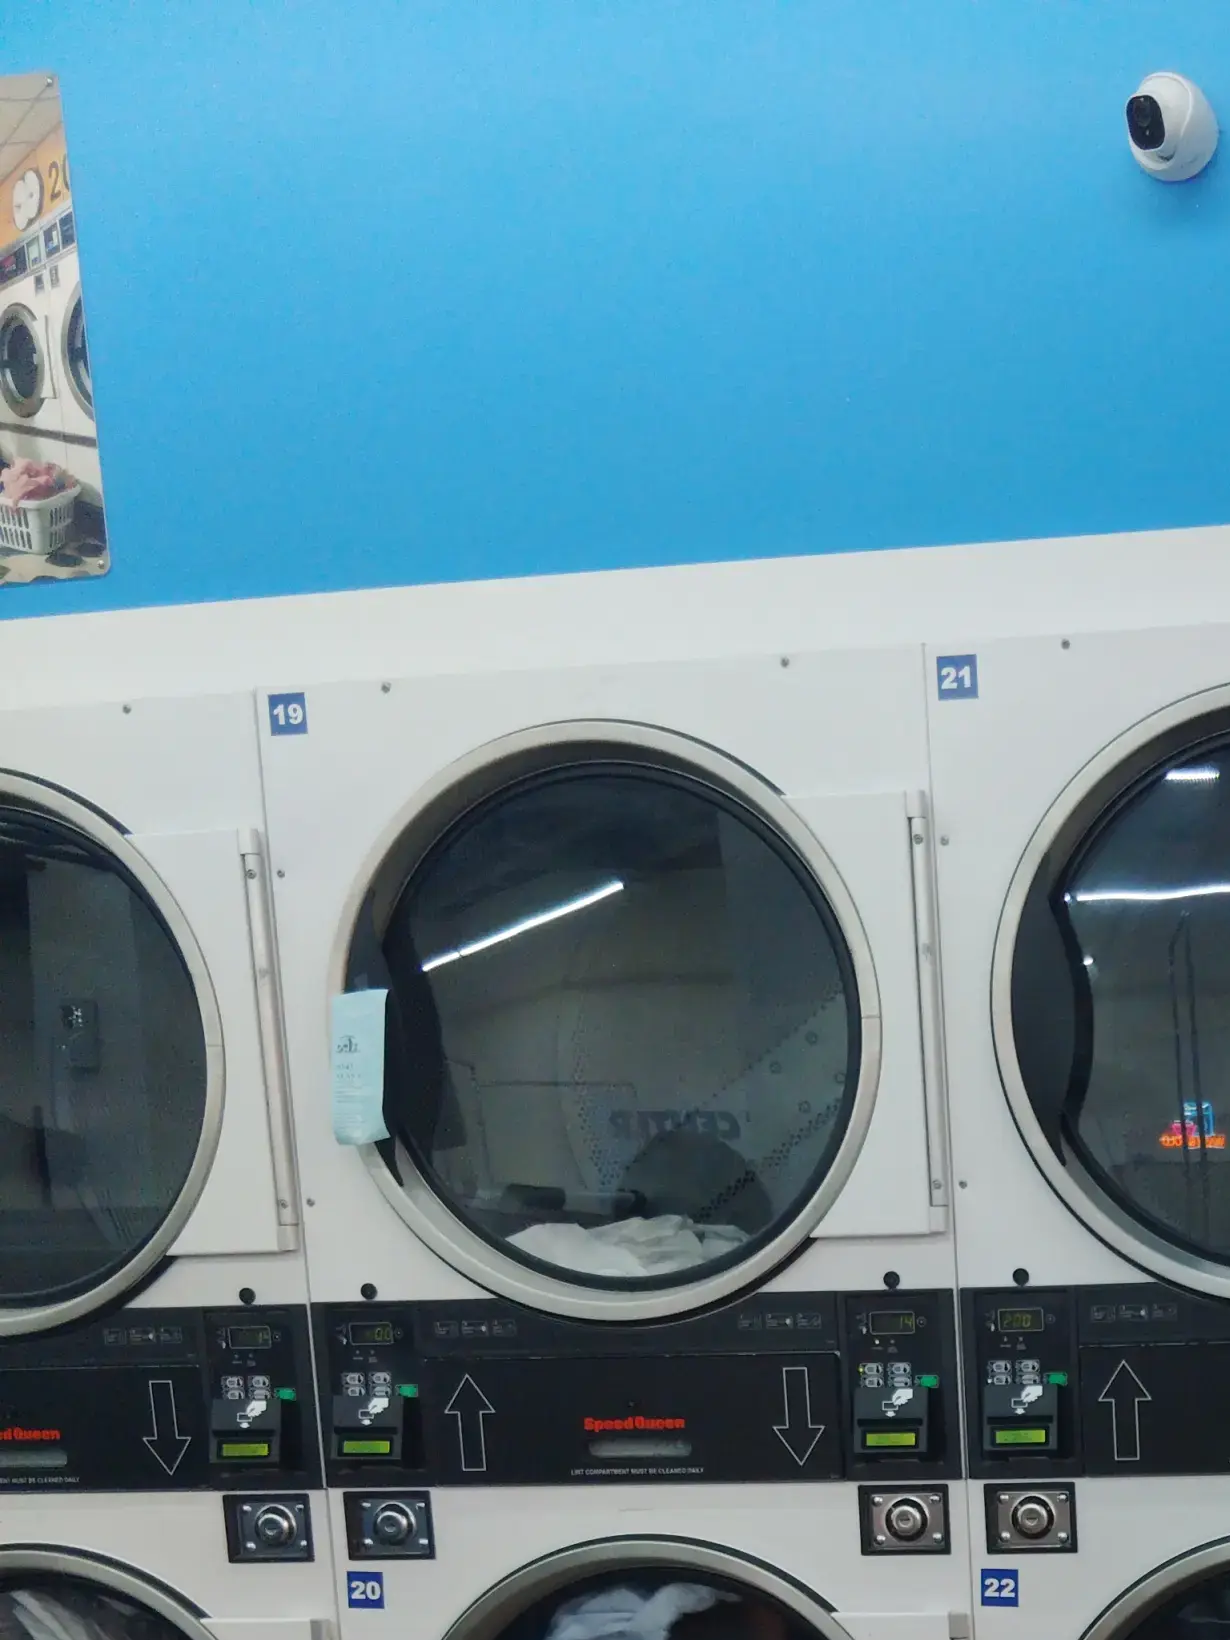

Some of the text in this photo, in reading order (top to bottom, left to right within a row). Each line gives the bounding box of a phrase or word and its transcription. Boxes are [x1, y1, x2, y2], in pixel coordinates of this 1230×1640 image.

[941, 666, 971, 689] 21
[273, 704, 303, 725] 19
[584, 1416, 685, 1432] Speed Queen
[351, 1581, 381, 1600] 20
[984, 1578, 1016, 1598] 22
